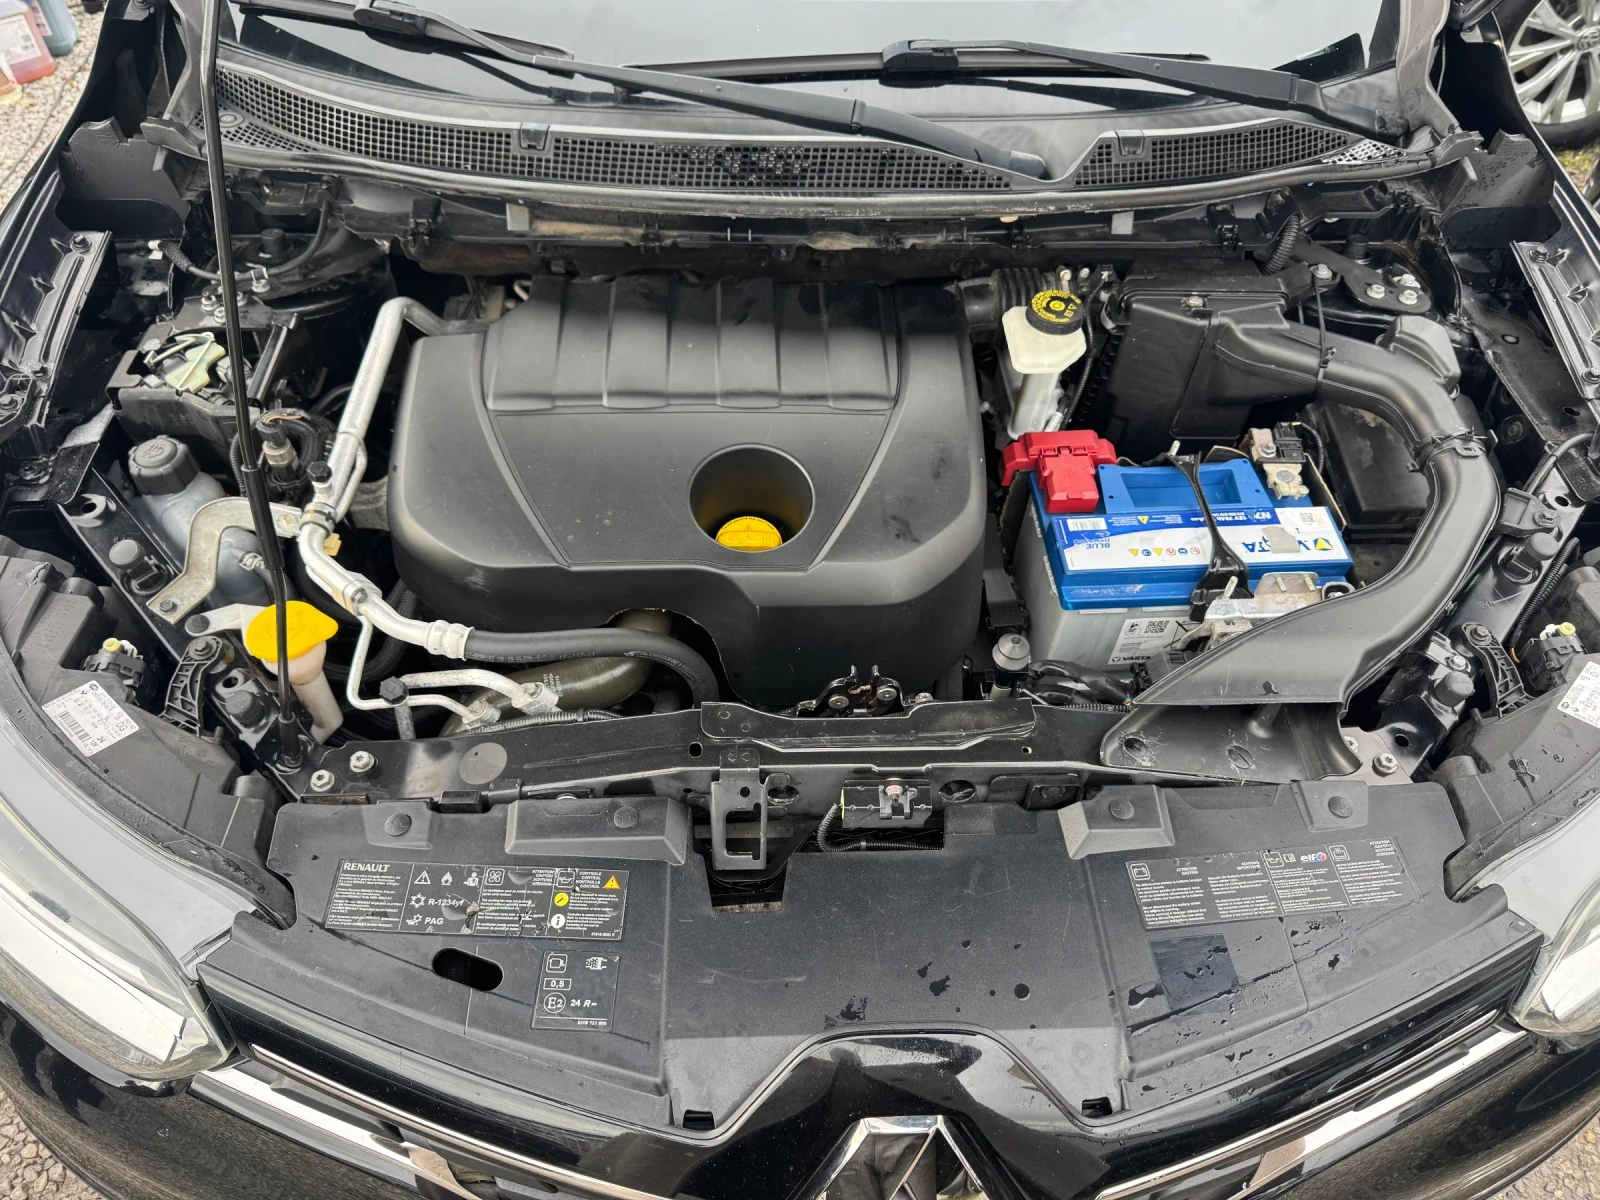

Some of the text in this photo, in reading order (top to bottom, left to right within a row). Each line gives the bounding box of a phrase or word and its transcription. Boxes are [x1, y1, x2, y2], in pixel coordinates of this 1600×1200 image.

[343, 862, 390, 872] RENAULT
[428, 898, 464, 908] R-1234yf
[424, 916, 444, 925] PAG
[550, 980, 564, 988] 0,5
[547, 997, 563, 1009] E2
[570, 999, 580, 1007] 24
